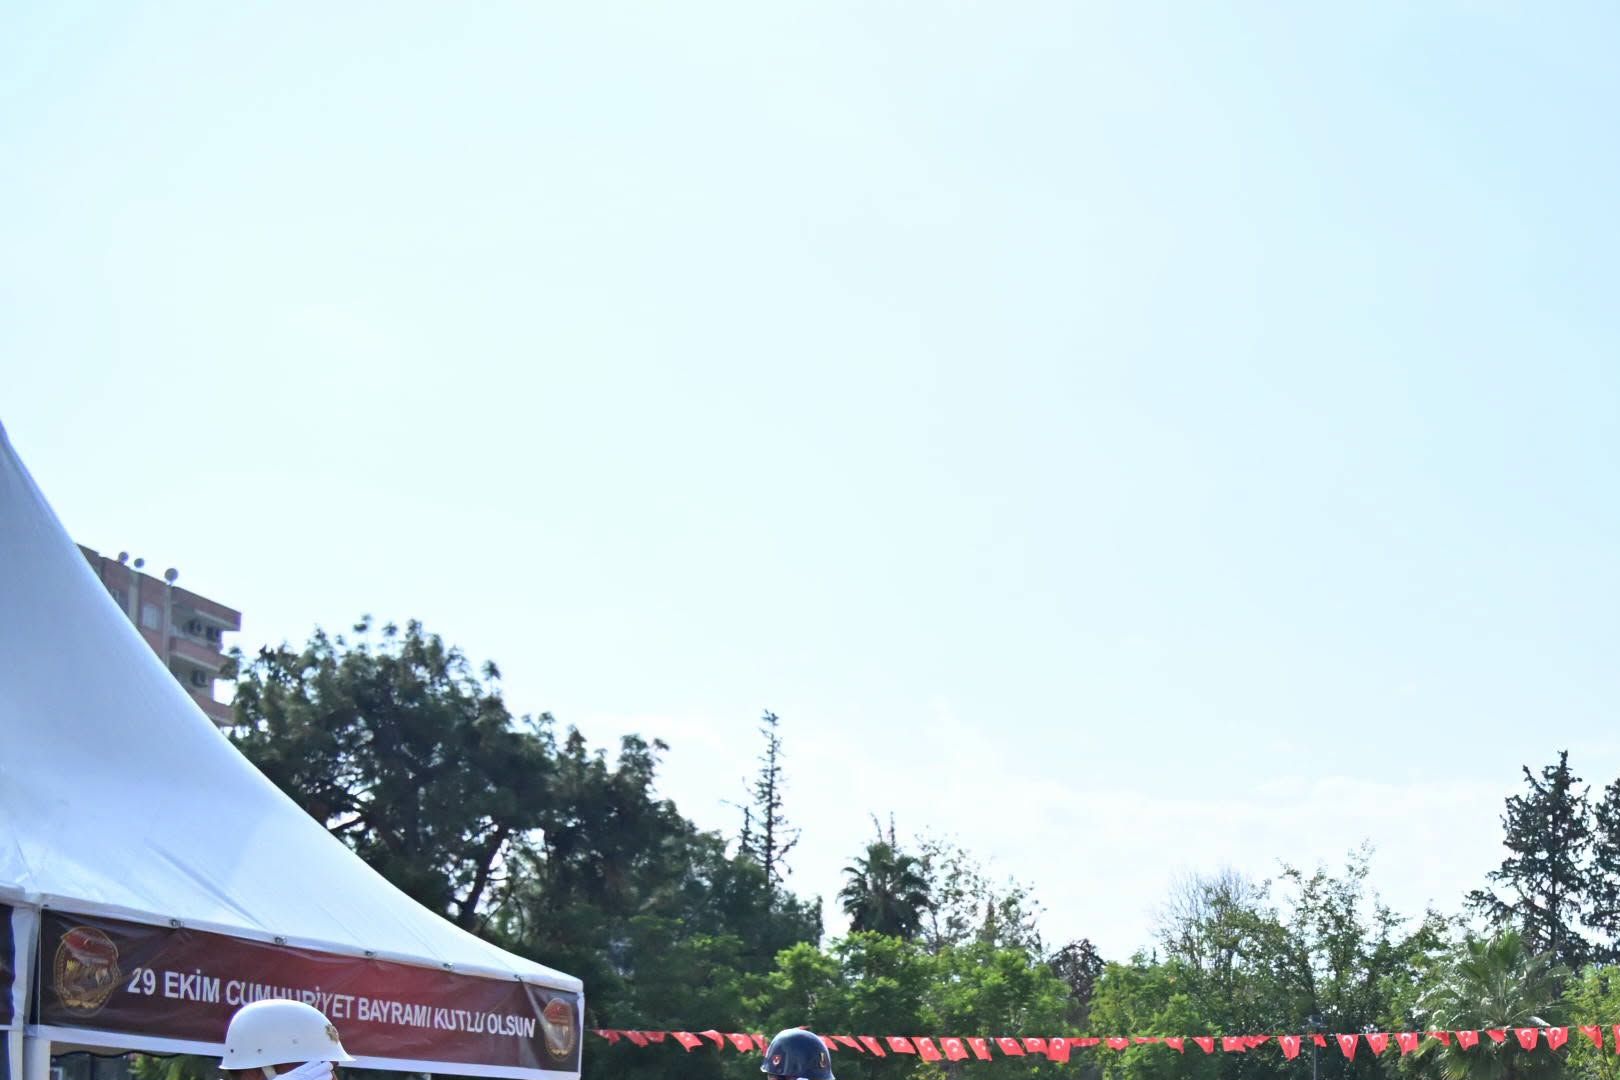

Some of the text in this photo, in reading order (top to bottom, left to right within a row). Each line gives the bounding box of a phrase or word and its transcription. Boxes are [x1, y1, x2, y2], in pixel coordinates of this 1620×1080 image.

[127, 967, 157, 995] 29
[164, 968, 220, 1003] EKİM
[358, 997, 431, 1028] BAYRAMI
[434, 1007, 486, 1033] KUTLU
[487, 1013, 536, 1038] OLSUN
